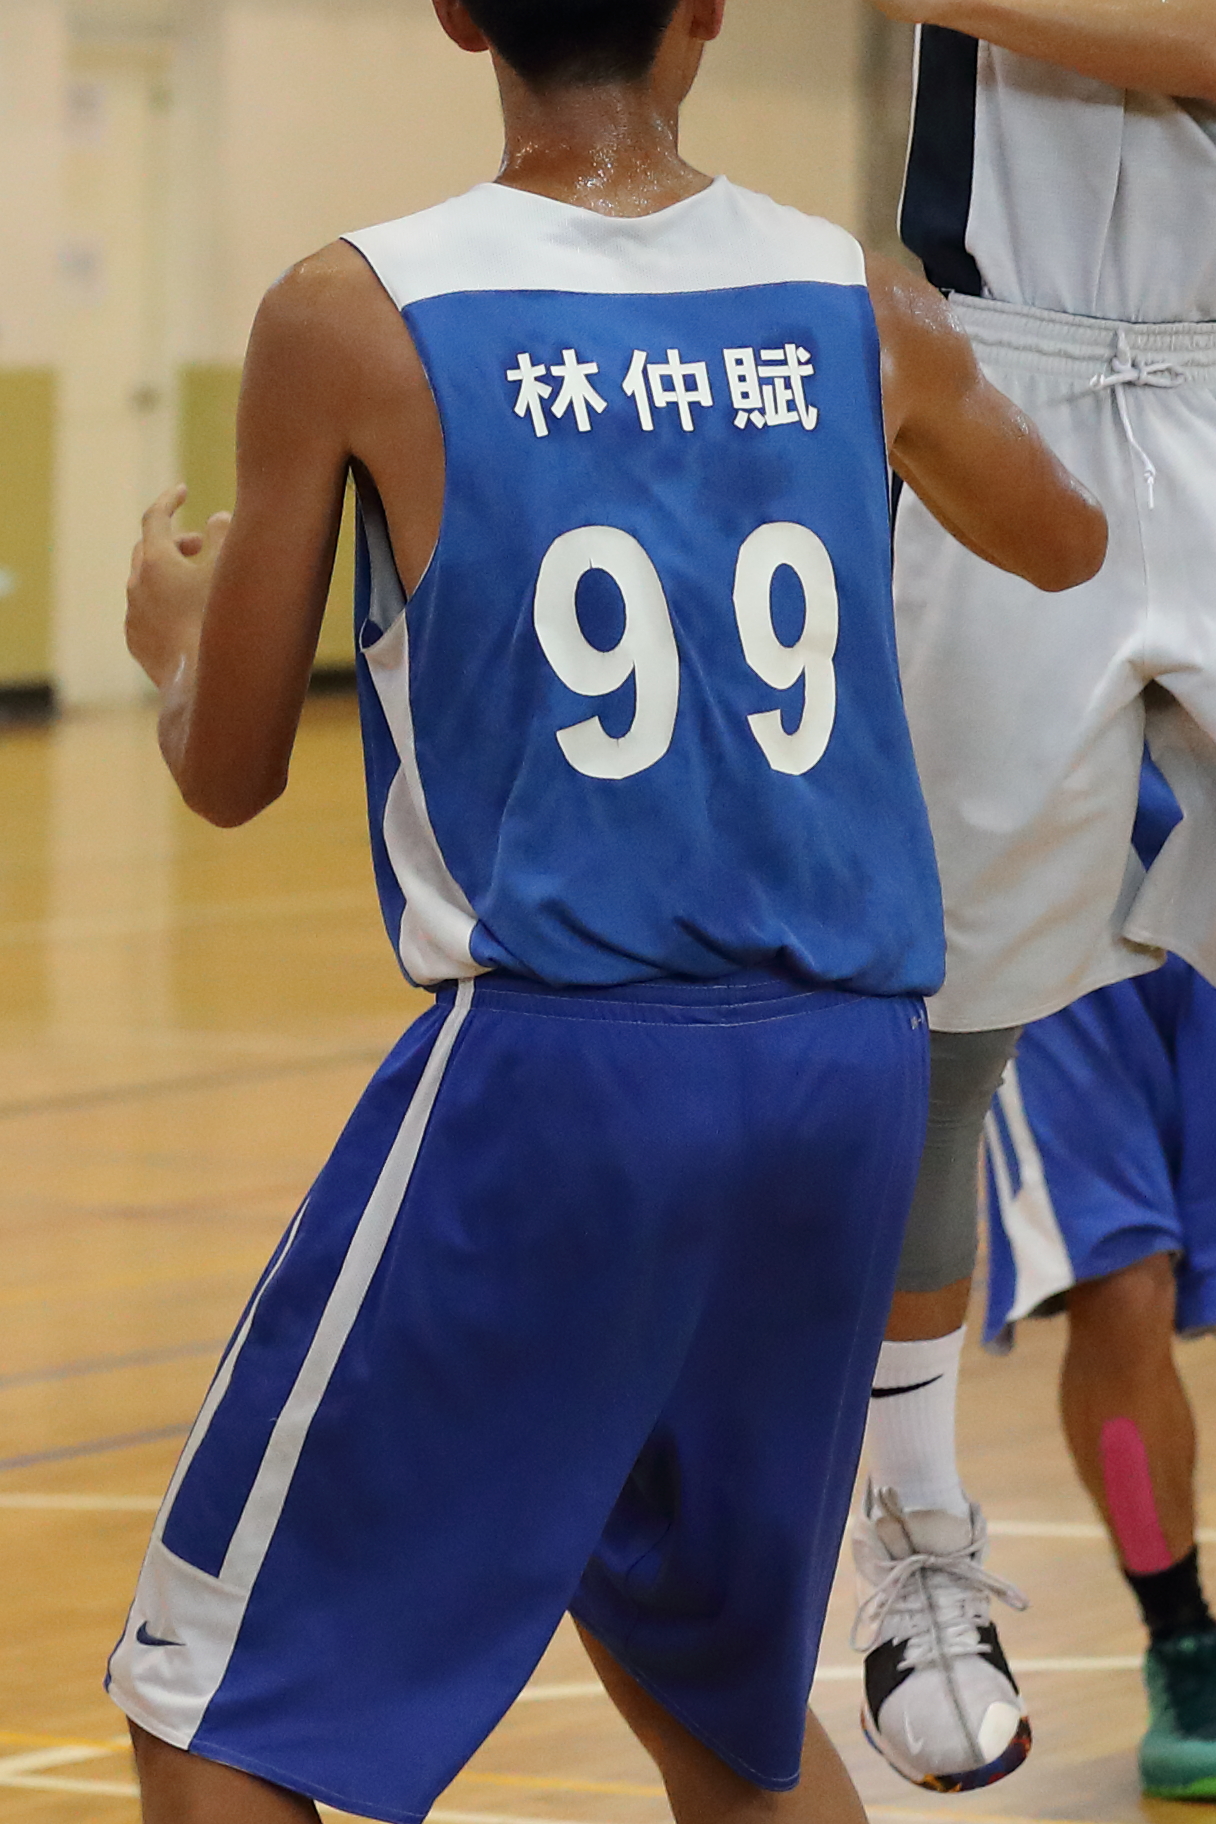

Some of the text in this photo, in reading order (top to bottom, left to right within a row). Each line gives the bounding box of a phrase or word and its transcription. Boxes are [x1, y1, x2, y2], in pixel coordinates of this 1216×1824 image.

[506, 343, 819, 438] 林仲賦
[533, 521, 840, 780] 99
